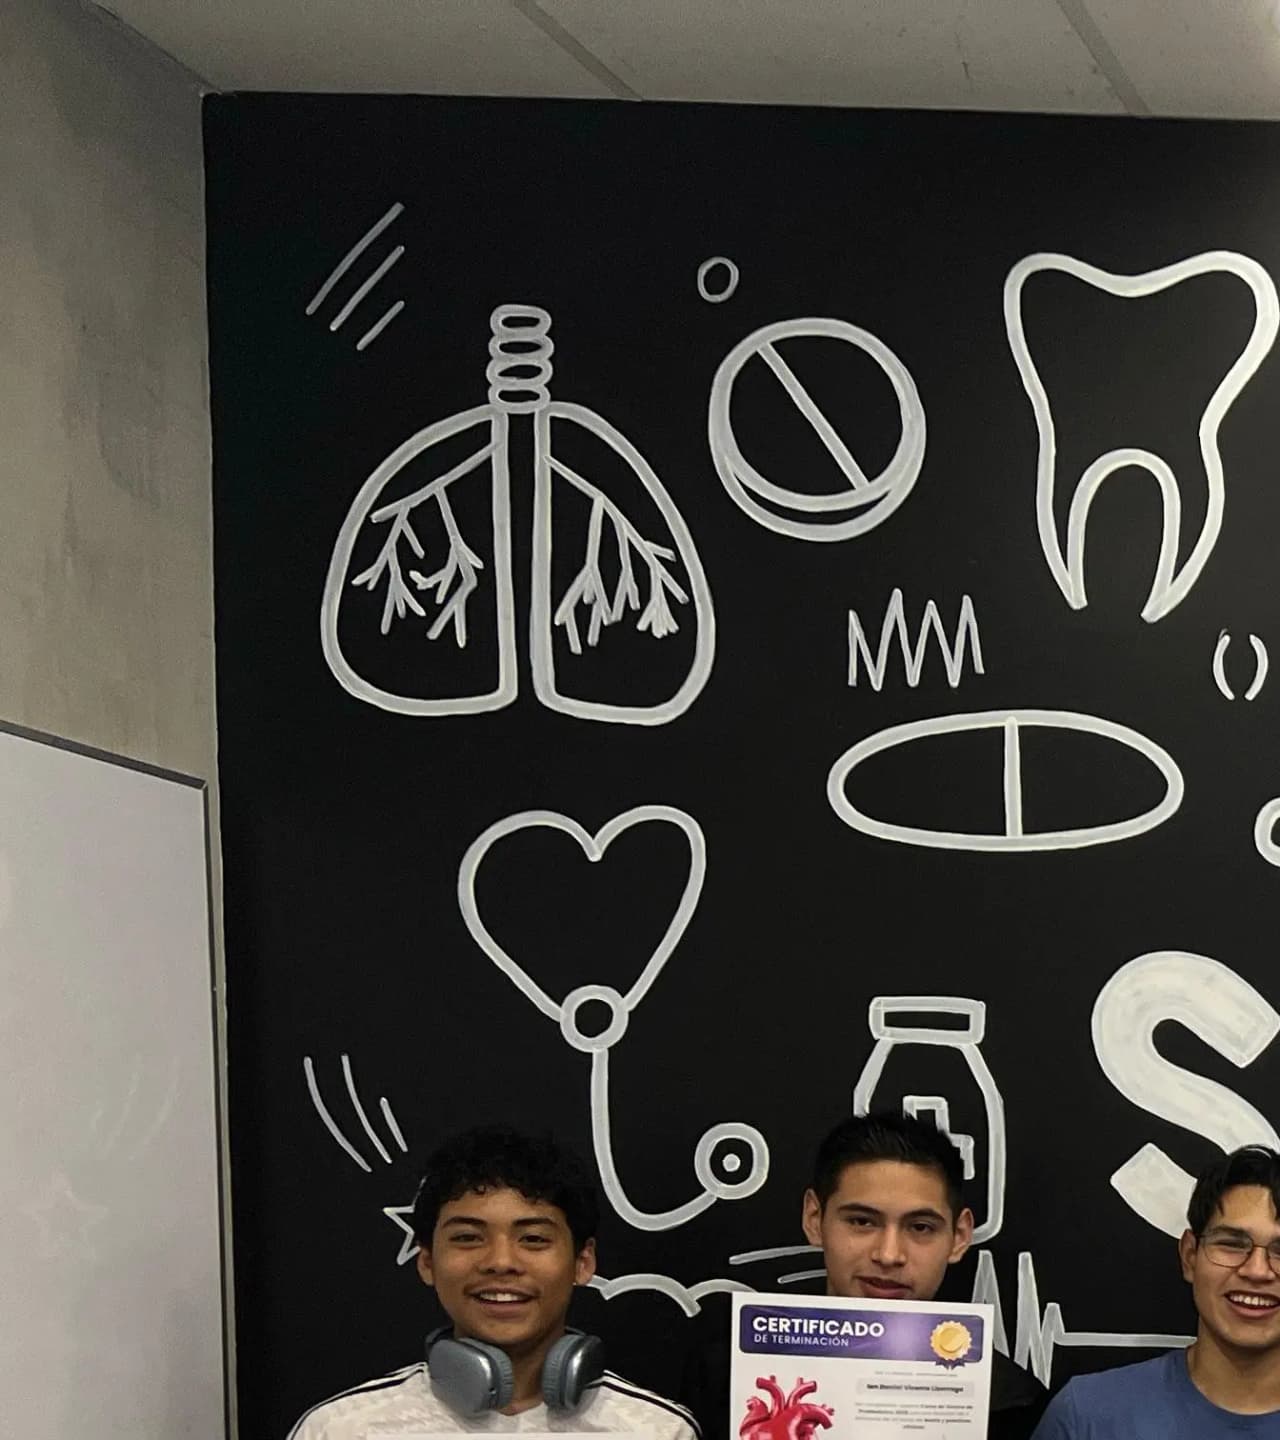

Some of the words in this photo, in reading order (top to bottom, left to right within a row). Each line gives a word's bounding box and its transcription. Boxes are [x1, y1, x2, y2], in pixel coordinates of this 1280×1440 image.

[753, 1316, 884, 1337] CERTIFICADO
[754, 1334, 767, 1343] DE
[772, 1335, 849, 1346] TERMINACIÓN
